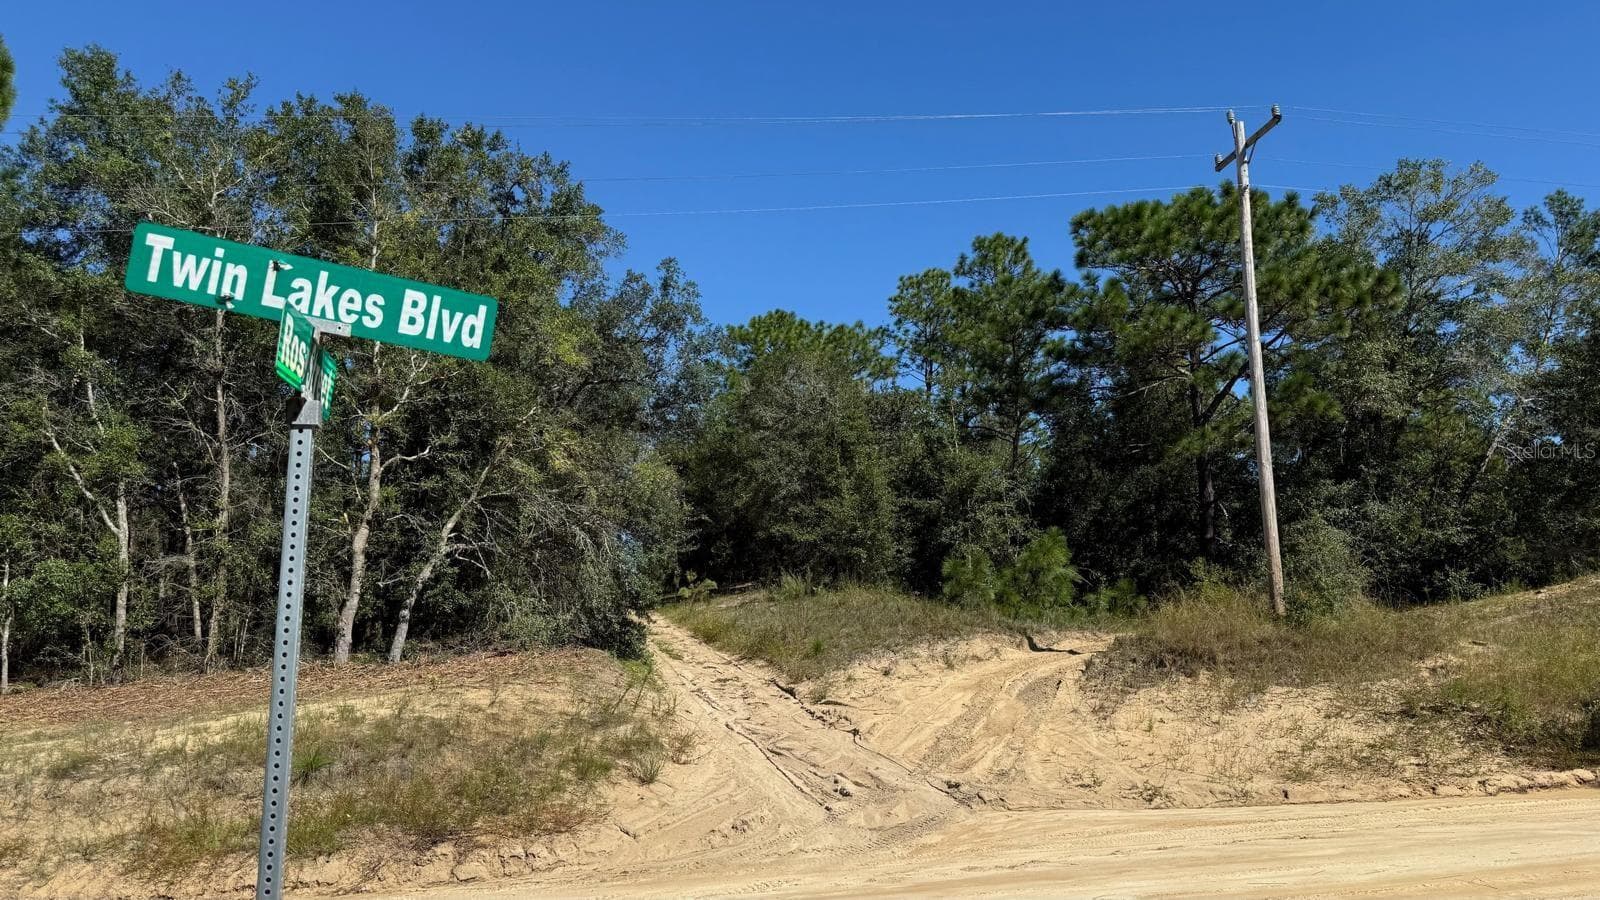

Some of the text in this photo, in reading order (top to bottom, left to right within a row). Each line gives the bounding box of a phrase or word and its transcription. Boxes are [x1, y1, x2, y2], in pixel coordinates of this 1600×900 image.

[145, 232, 488, 350] Twin Lakes Blvd
[281, 311, 308, 378] Ros
